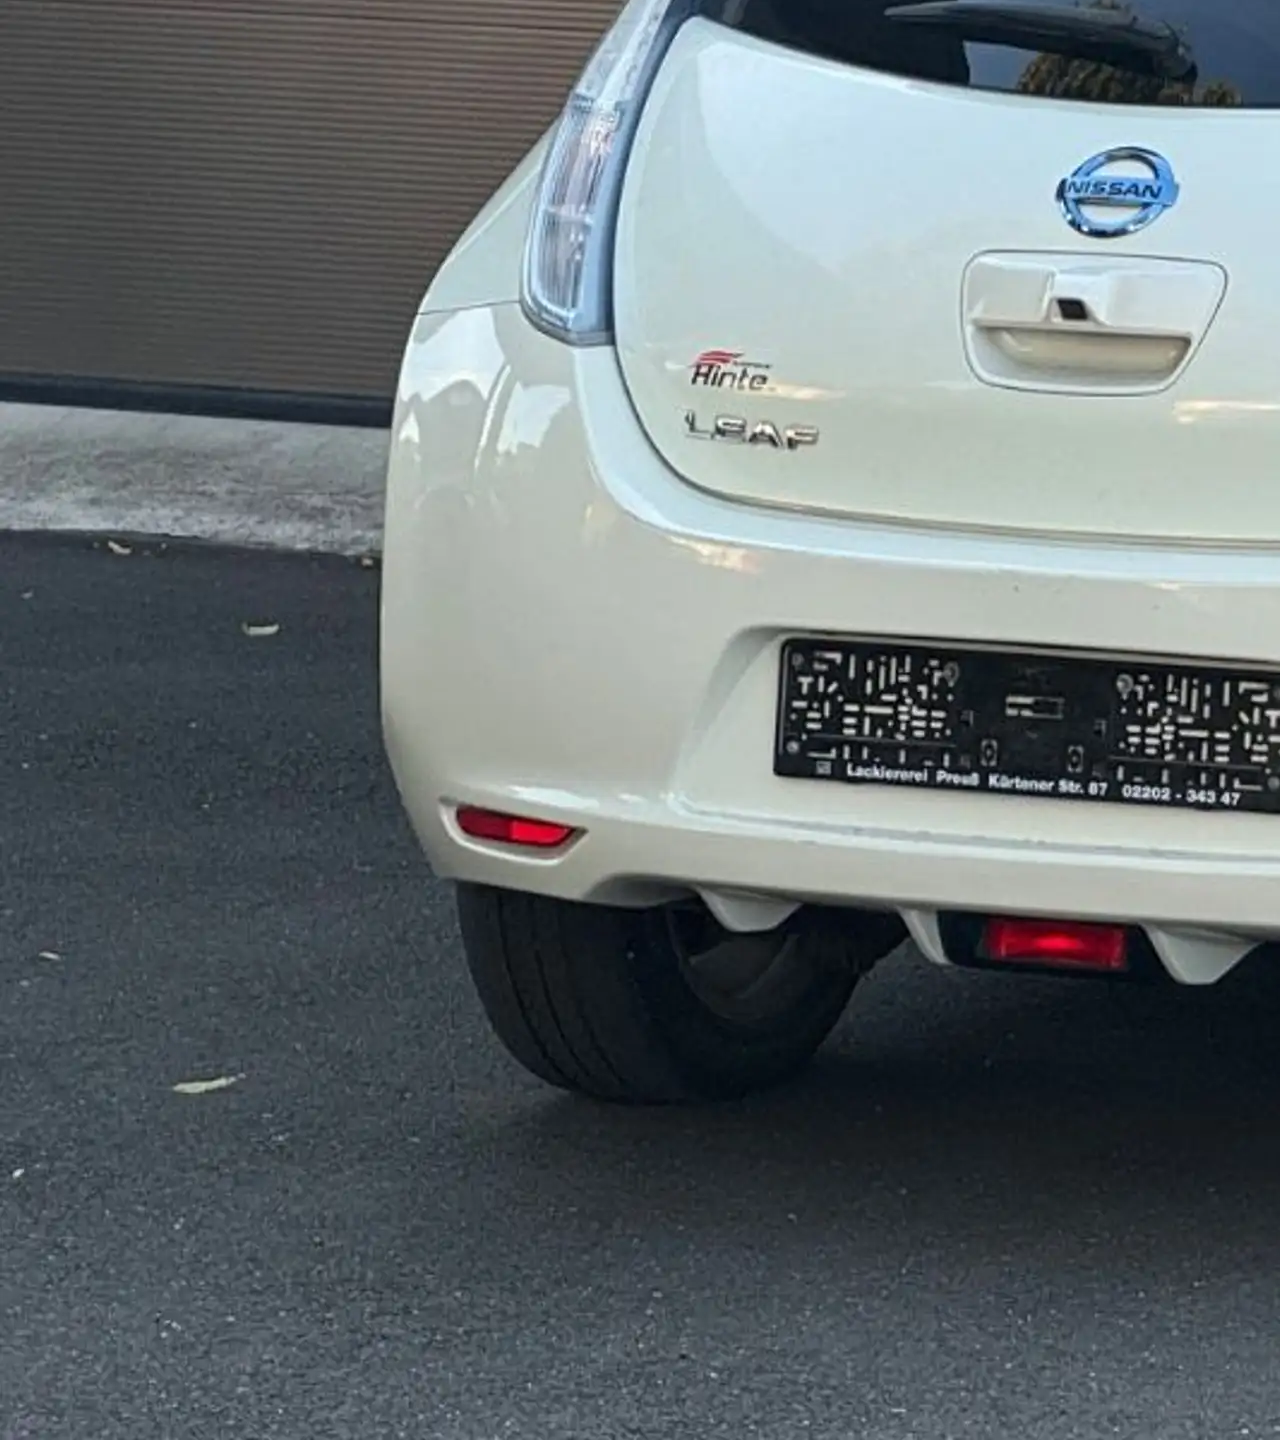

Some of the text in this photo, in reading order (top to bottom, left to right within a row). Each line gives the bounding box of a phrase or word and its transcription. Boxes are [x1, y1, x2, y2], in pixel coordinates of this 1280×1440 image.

[1067, 180, 1163, 199] NISSAN
[685, 409, 820, 450] LEAF
[1058, 779, 1084, 794] Str.
[1122, 784, 1171, 801] 02202
[1220, 791, 1241, 806] 47
